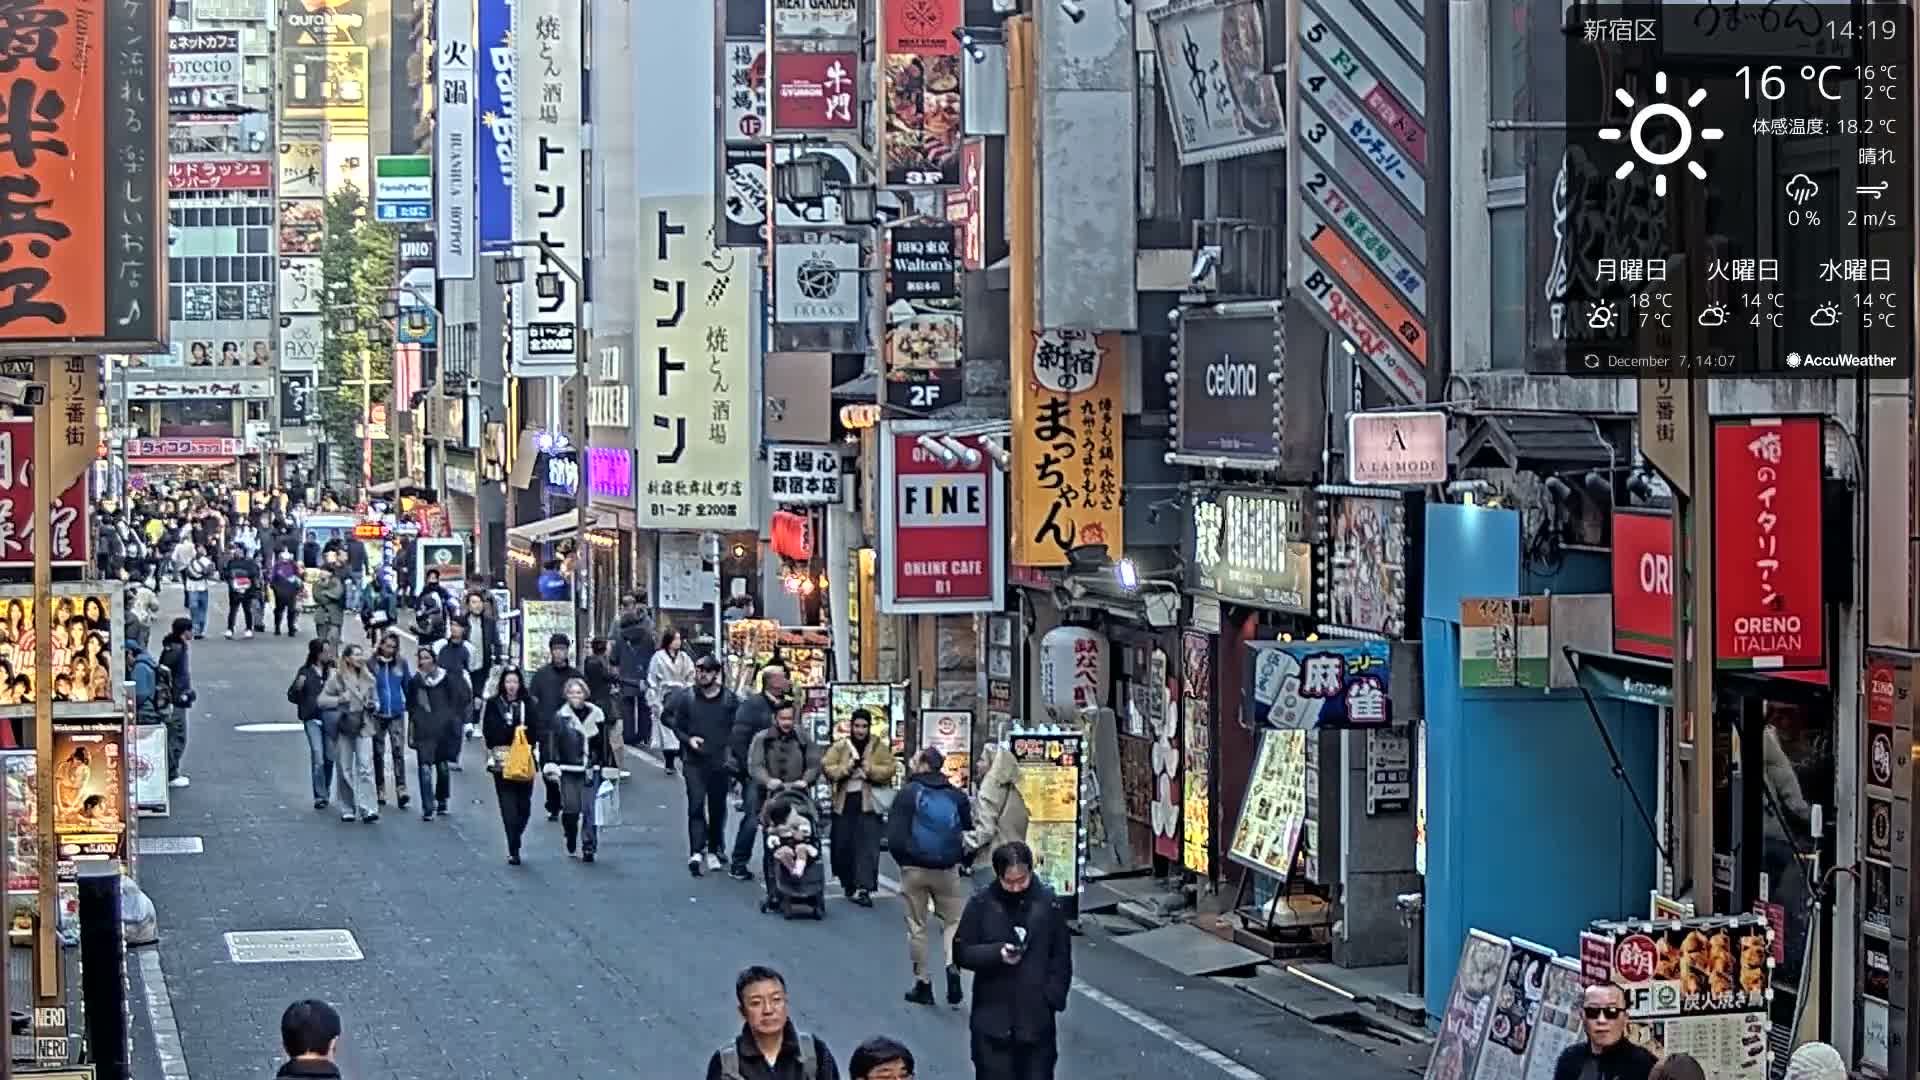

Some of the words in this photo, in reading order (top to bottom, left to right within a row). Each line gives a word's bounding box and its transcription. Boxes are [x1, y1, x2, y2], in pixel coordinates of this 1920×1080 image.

[1307, 23, 1327, 43] 5
[443, 40, 468, 105] 火鍋
[536, 15, 562, 124] 焼とん酒場
[824, 60, 851, 121] 牛門
[741, 119, 761, 133] 1F
[1308, 75, 1326, 92] 4
[1350, 118, 1405, 179] センチュリー
[1308, 123, 1327, 143] 3
[906, 171, 944, 184] 3F
[1306, 173, 1327, 194] 2
[535, 137, 565, 312] トントン
[1311, 223, 1325, 241] 1
[894, 257, 952, 272] Walton's
[1305, 270, 1332, 299] B1
[653, 210, 686, 463] トントン
[706, 326, 730, 444] 焼とん酒場
[1206, 354, 1257, 396] celona
[65, 356, 85, 446] 通り一番街
[910, 386, 940, 406] 2F
[773, 451, 838, 472] 酒場心
[1080, 399, 1097, 509] 九州のうまかもん
[1396, 461, 1439, 472] MODE
[773, 476, 837, 494] 新宿本店
[1034, 397, 1079, 550] まっちゃん
[905, 486, 980, 515] FINE
[1748, 432, 1782, 605] 俺のイタリアン
[904, 561, 948, 576] ONLINE
[951, 561, 983, 575] CAFE
[1734, 616, 1801, 634] ORENO
[1734, 635, 1802, 653] ITALIAN
[1305, 655, 1386, 722] 麻雀
[1683, 991, 1764, 1011] 炭火焼き鳥
